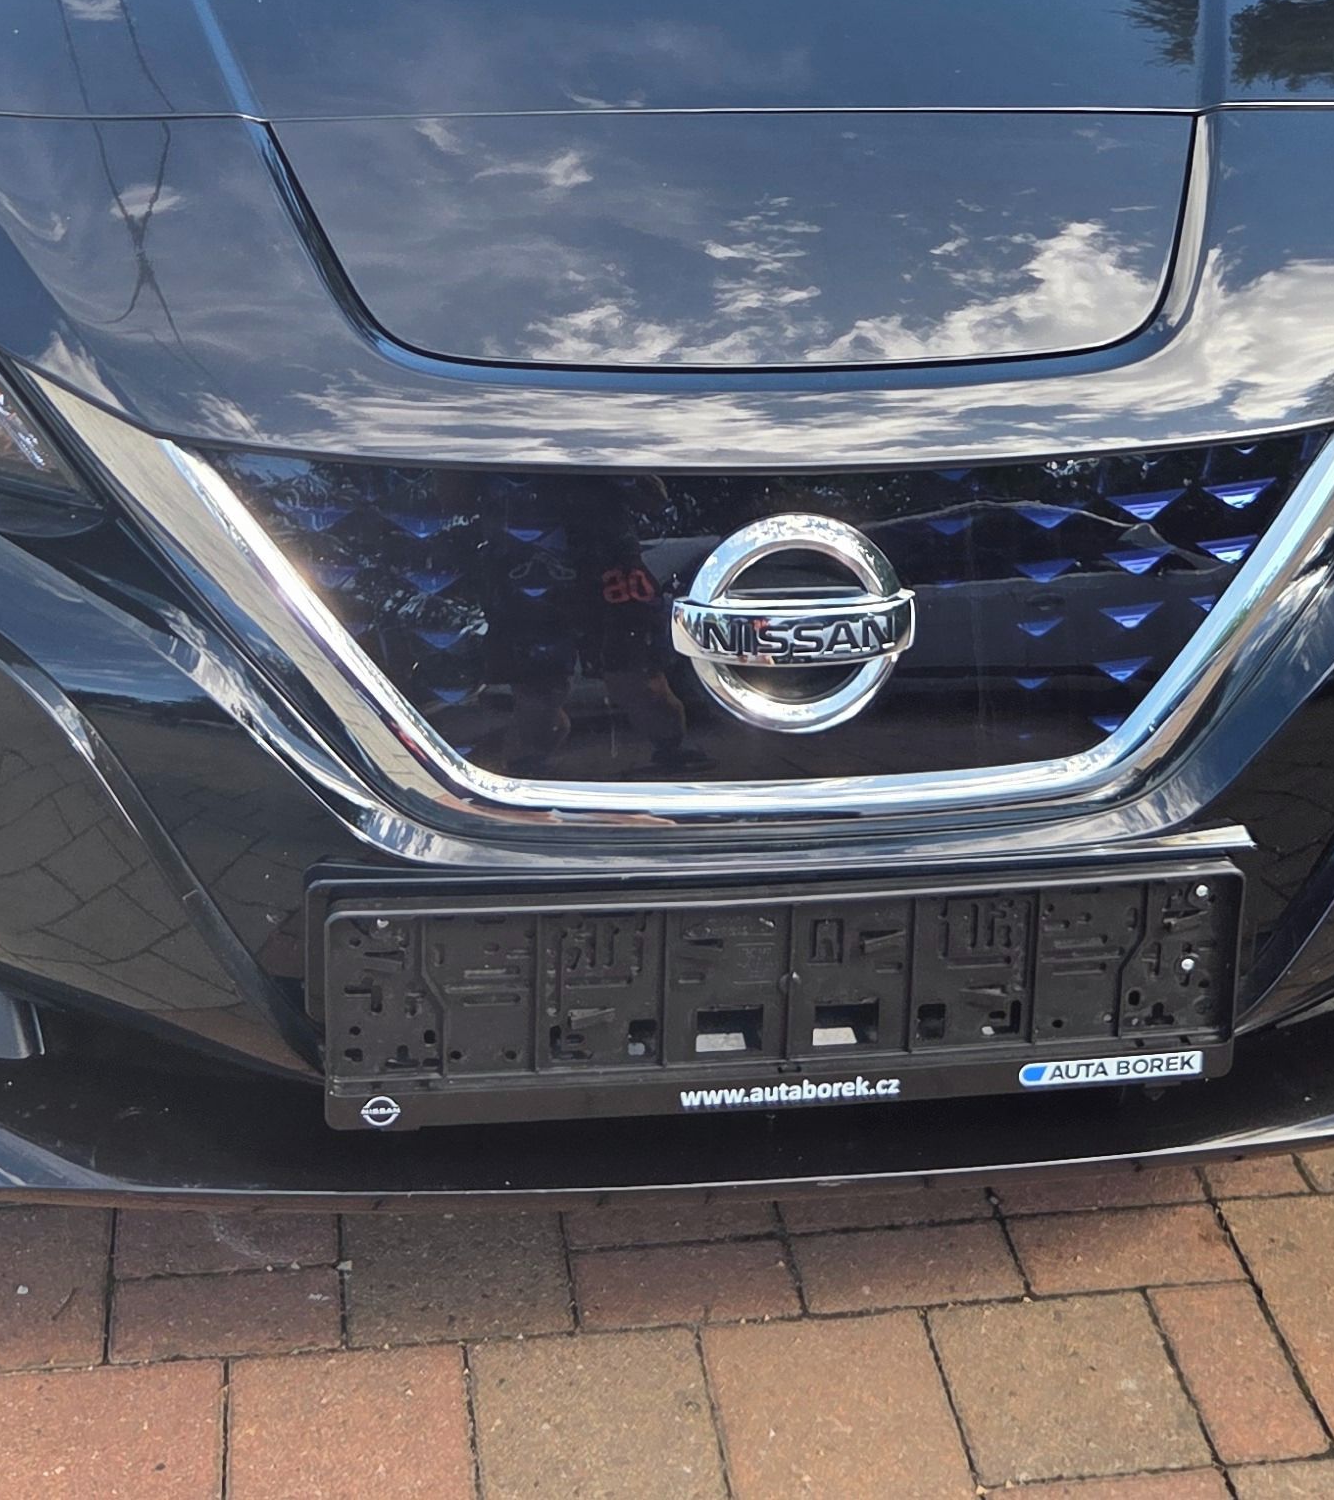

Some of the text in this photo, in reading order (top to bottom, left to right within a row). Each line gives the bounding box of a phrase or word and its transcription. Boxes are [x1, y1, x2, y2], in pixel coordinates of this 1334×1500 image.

[702, 618, 896, 658] NISSAN
[1048, 1054, 1196, 1082] AUTA BOREK
[680, 1076, 900, 1107] www.autaborek.cz
